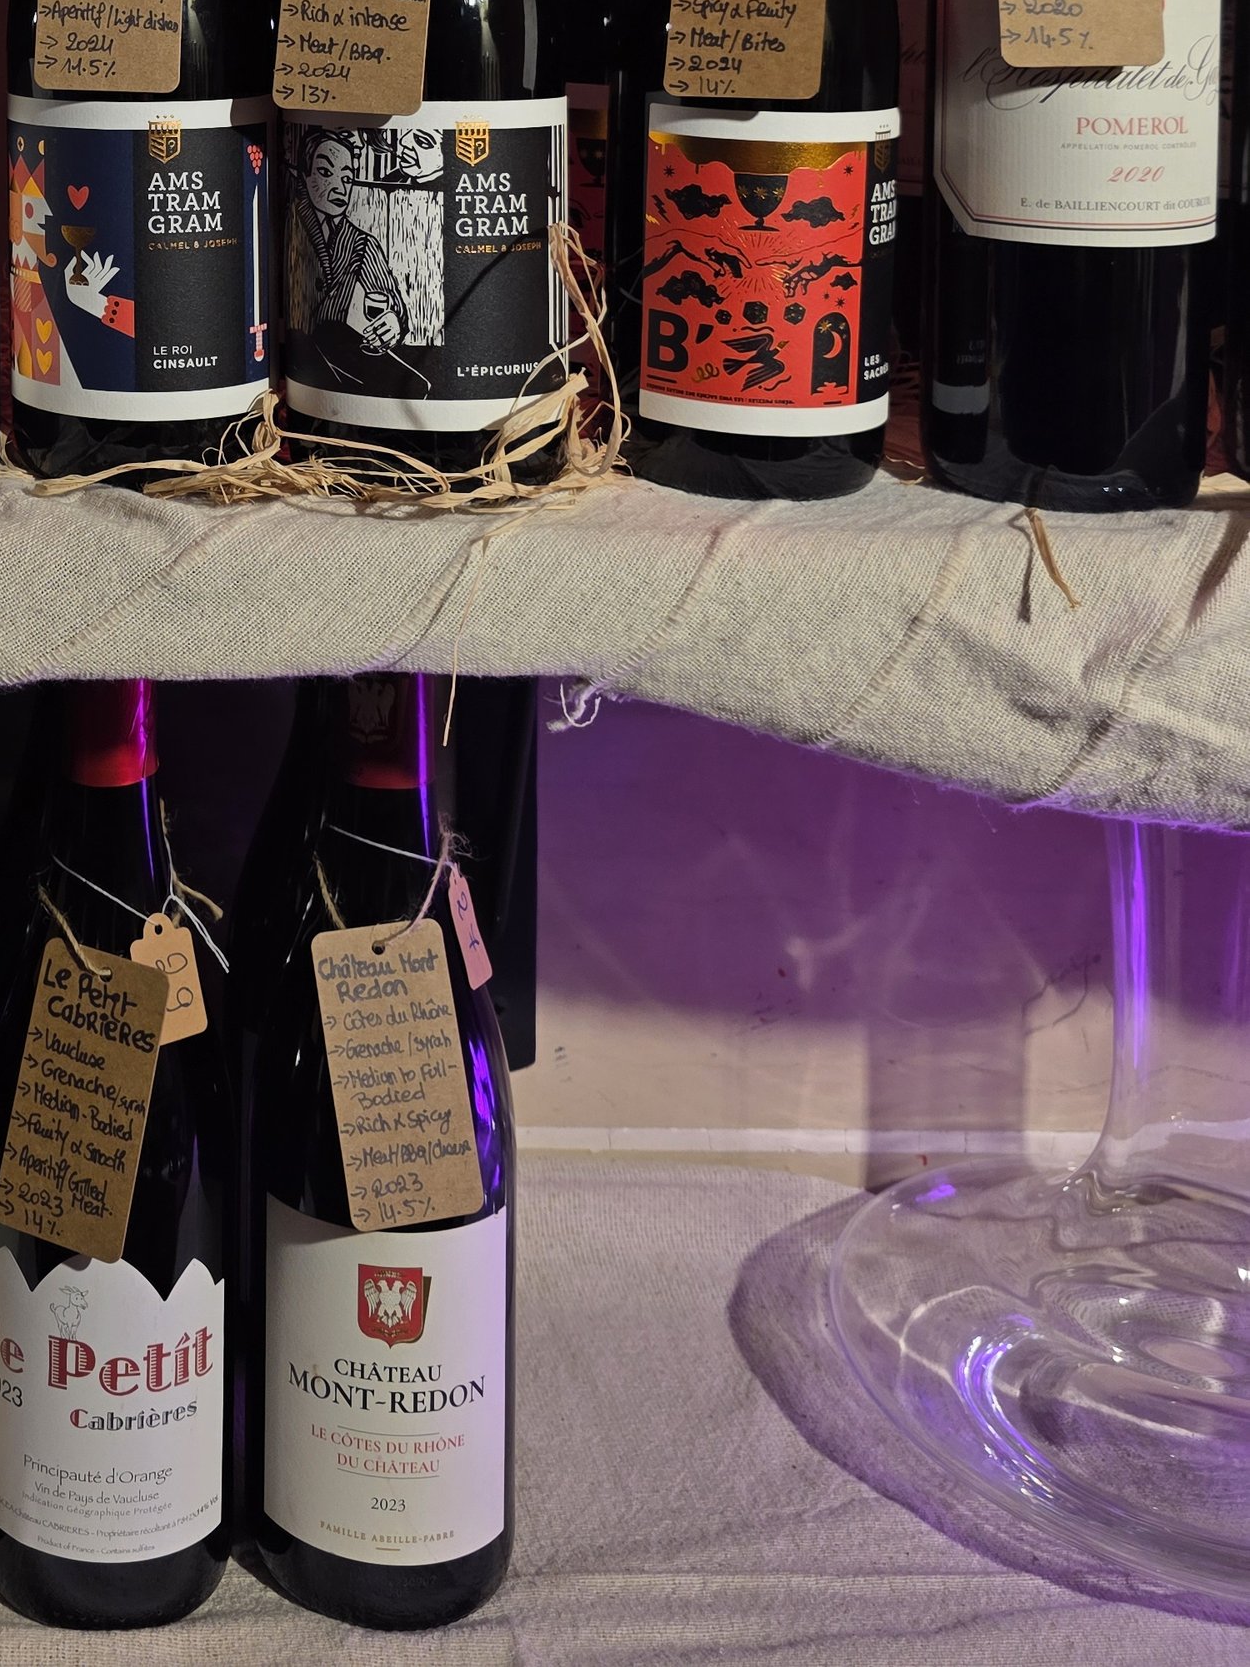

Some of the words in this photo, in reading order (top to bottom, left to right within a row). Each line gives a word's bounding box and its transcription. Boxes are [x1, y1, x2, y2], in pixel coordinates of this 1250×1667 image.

[301, 6, 329, 23] Rich
[350, 11, 410, 31] intense
[66, 33, 113, 52] 2024
[298, 66, 350, 79] 2024
[688, 56, 742, 73] 2024
[1076, 117, 1189, 135] POMEROL
[148, 171, 204, 192] AMS
[455, 173, 510, 193] AMS
[1107, 166, 1165, 183] 2020
[871, 180, 896, 202] AMS
[148, 192, 221, 212] TRAM
[455, 193, 527, 214] TRAM
[1021, 198, 1032, 209] E.
[1036, 199, 1051, 209] de
[1055, 200, 1161, 211] BAILLIENCOURT
[1163, 201, 1176, 211] dit
[148, 213, 223, 234] GRAM
[455, 216, 529, 237] GRAM
[153, 346, 167, 355] LE
[172, 345, 192, 355] ROI
[865, 354, 879, 367] LES
[153, 356, 217, 370] CINSAULT
[457, 362, 539, 377] L'ÉPICURIUS
[43, 959, 72, 988] Le
[336, 978, 408, 1003] Redon
[387, 1006, 409, 1026] du
[411, 1001, 452, 1023] Rhône
[352, 1083, 425, 1109] Bodied
[371, 1174, 423, 1199] 2023
[18, 1183, 64, 1216] 2023
[48, 1326, 213, 1396] Petit
[334, 1358, 442, 1382] CHÂTEAU
[288, 1362, 486, 1414] MONT-REDON
[70, 1399, 198, 1431] Cabrières
[311, 1424, 326, 1440] LE
[331, 1432, 381, 1453] CÔTES
[386, 1439, 408, 1454] DU
[414, 1435, 465, 1455] RHÔNE
[23, 1454, 102, 1484] Principauté
[107, 1465, 173, 1485] d'Orange
[337, 1452, 359, 1468] DU
[363, 1458, 440, 1474] CHÂTEAU
[35, 1481, 50, 1497] Vin
[53, 1487, 66, 1500] de
[69, 1492, 94, 1507] Pays
[98, 1493, 111, 1505] de
[113, 1490, 160, 1504] Vaucluse
[370, 1497, 406, 1512] 2023
[22, 1490, 64, 1512] Indication
[67, 1503, 130, 1520] Géographique
[134, 1501, 173, 1515] Protégée
[320, 1521, 366, 1540] FAMILLE
